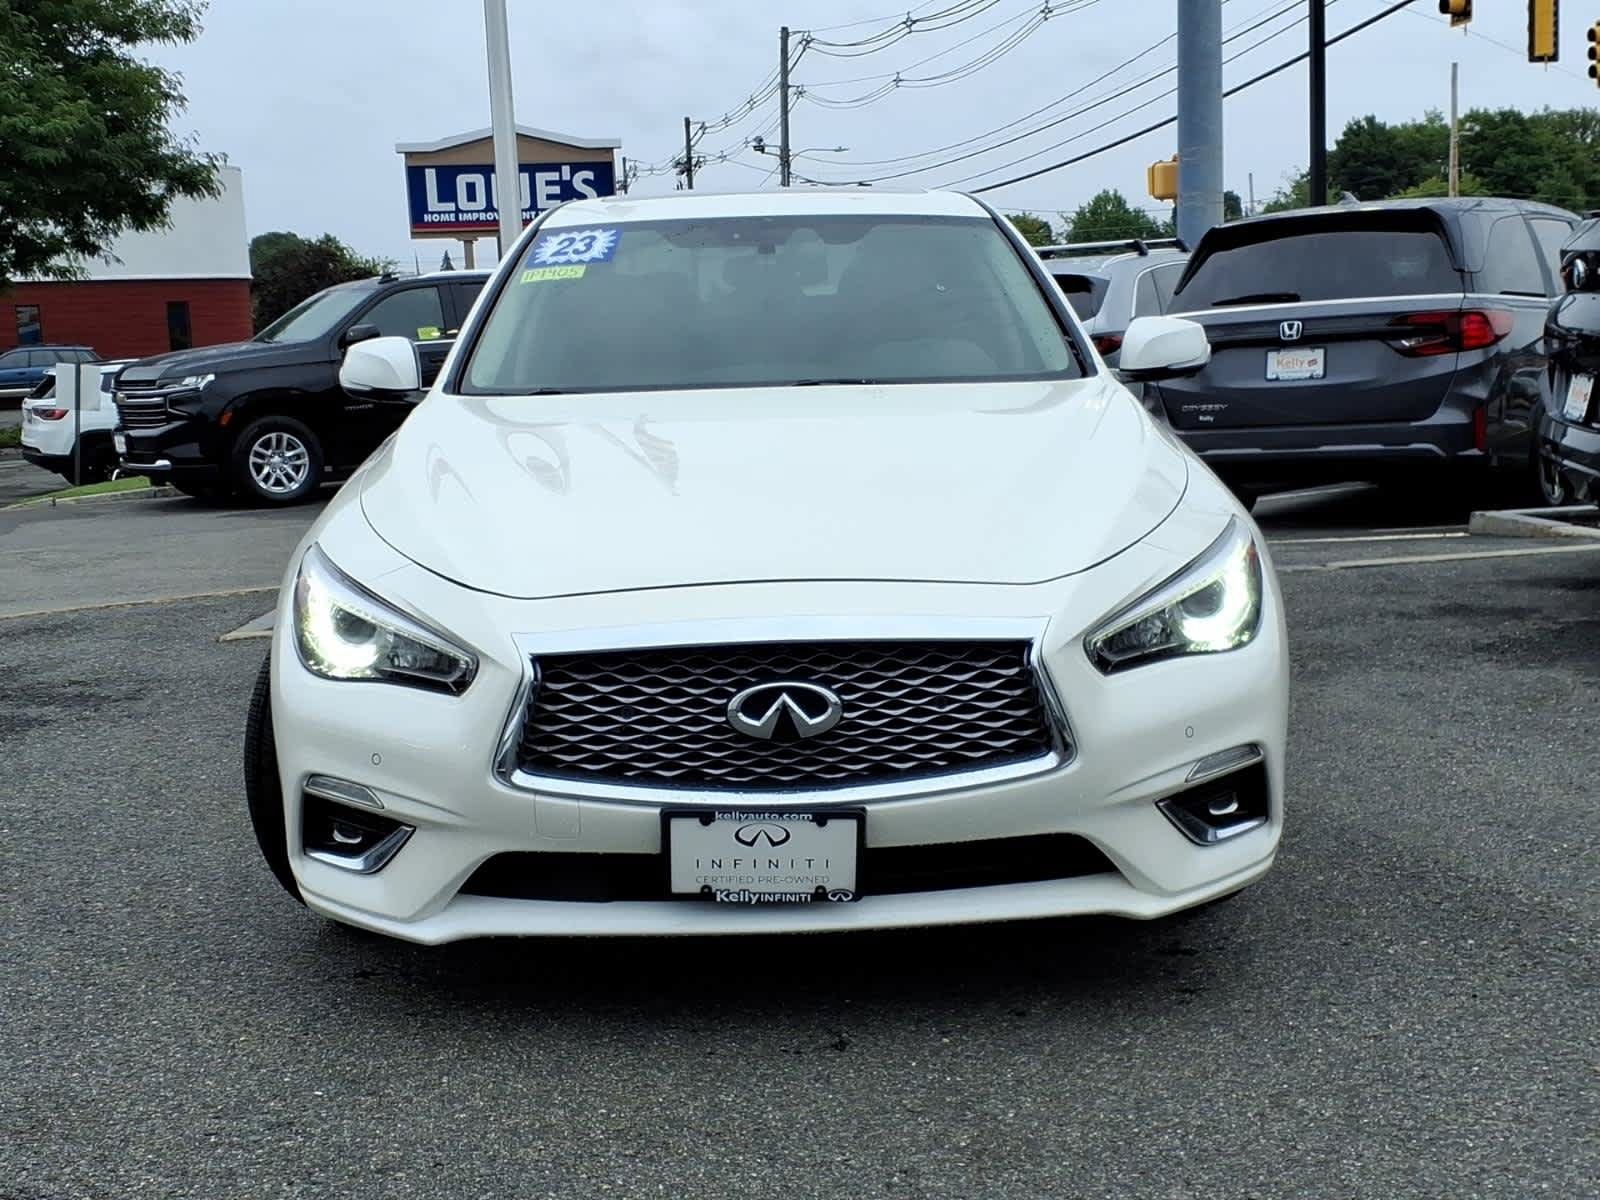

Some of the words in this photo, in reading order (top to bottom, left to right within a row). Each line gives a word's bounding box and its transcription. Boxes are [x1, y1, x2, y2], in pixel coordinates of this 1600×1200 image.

[424, 212, 456, 223] HOME
[459, 211, 537, 222] IMPROVNT
[549, 235, 597, 257] 23
[715, 811, 813, 823] kellyauto.com
[696, 858, 830, 869] INFINITI
[695, 875, 754, 884] CERTIFIED
[758, 875, 830, 884] PRE-OWNED
